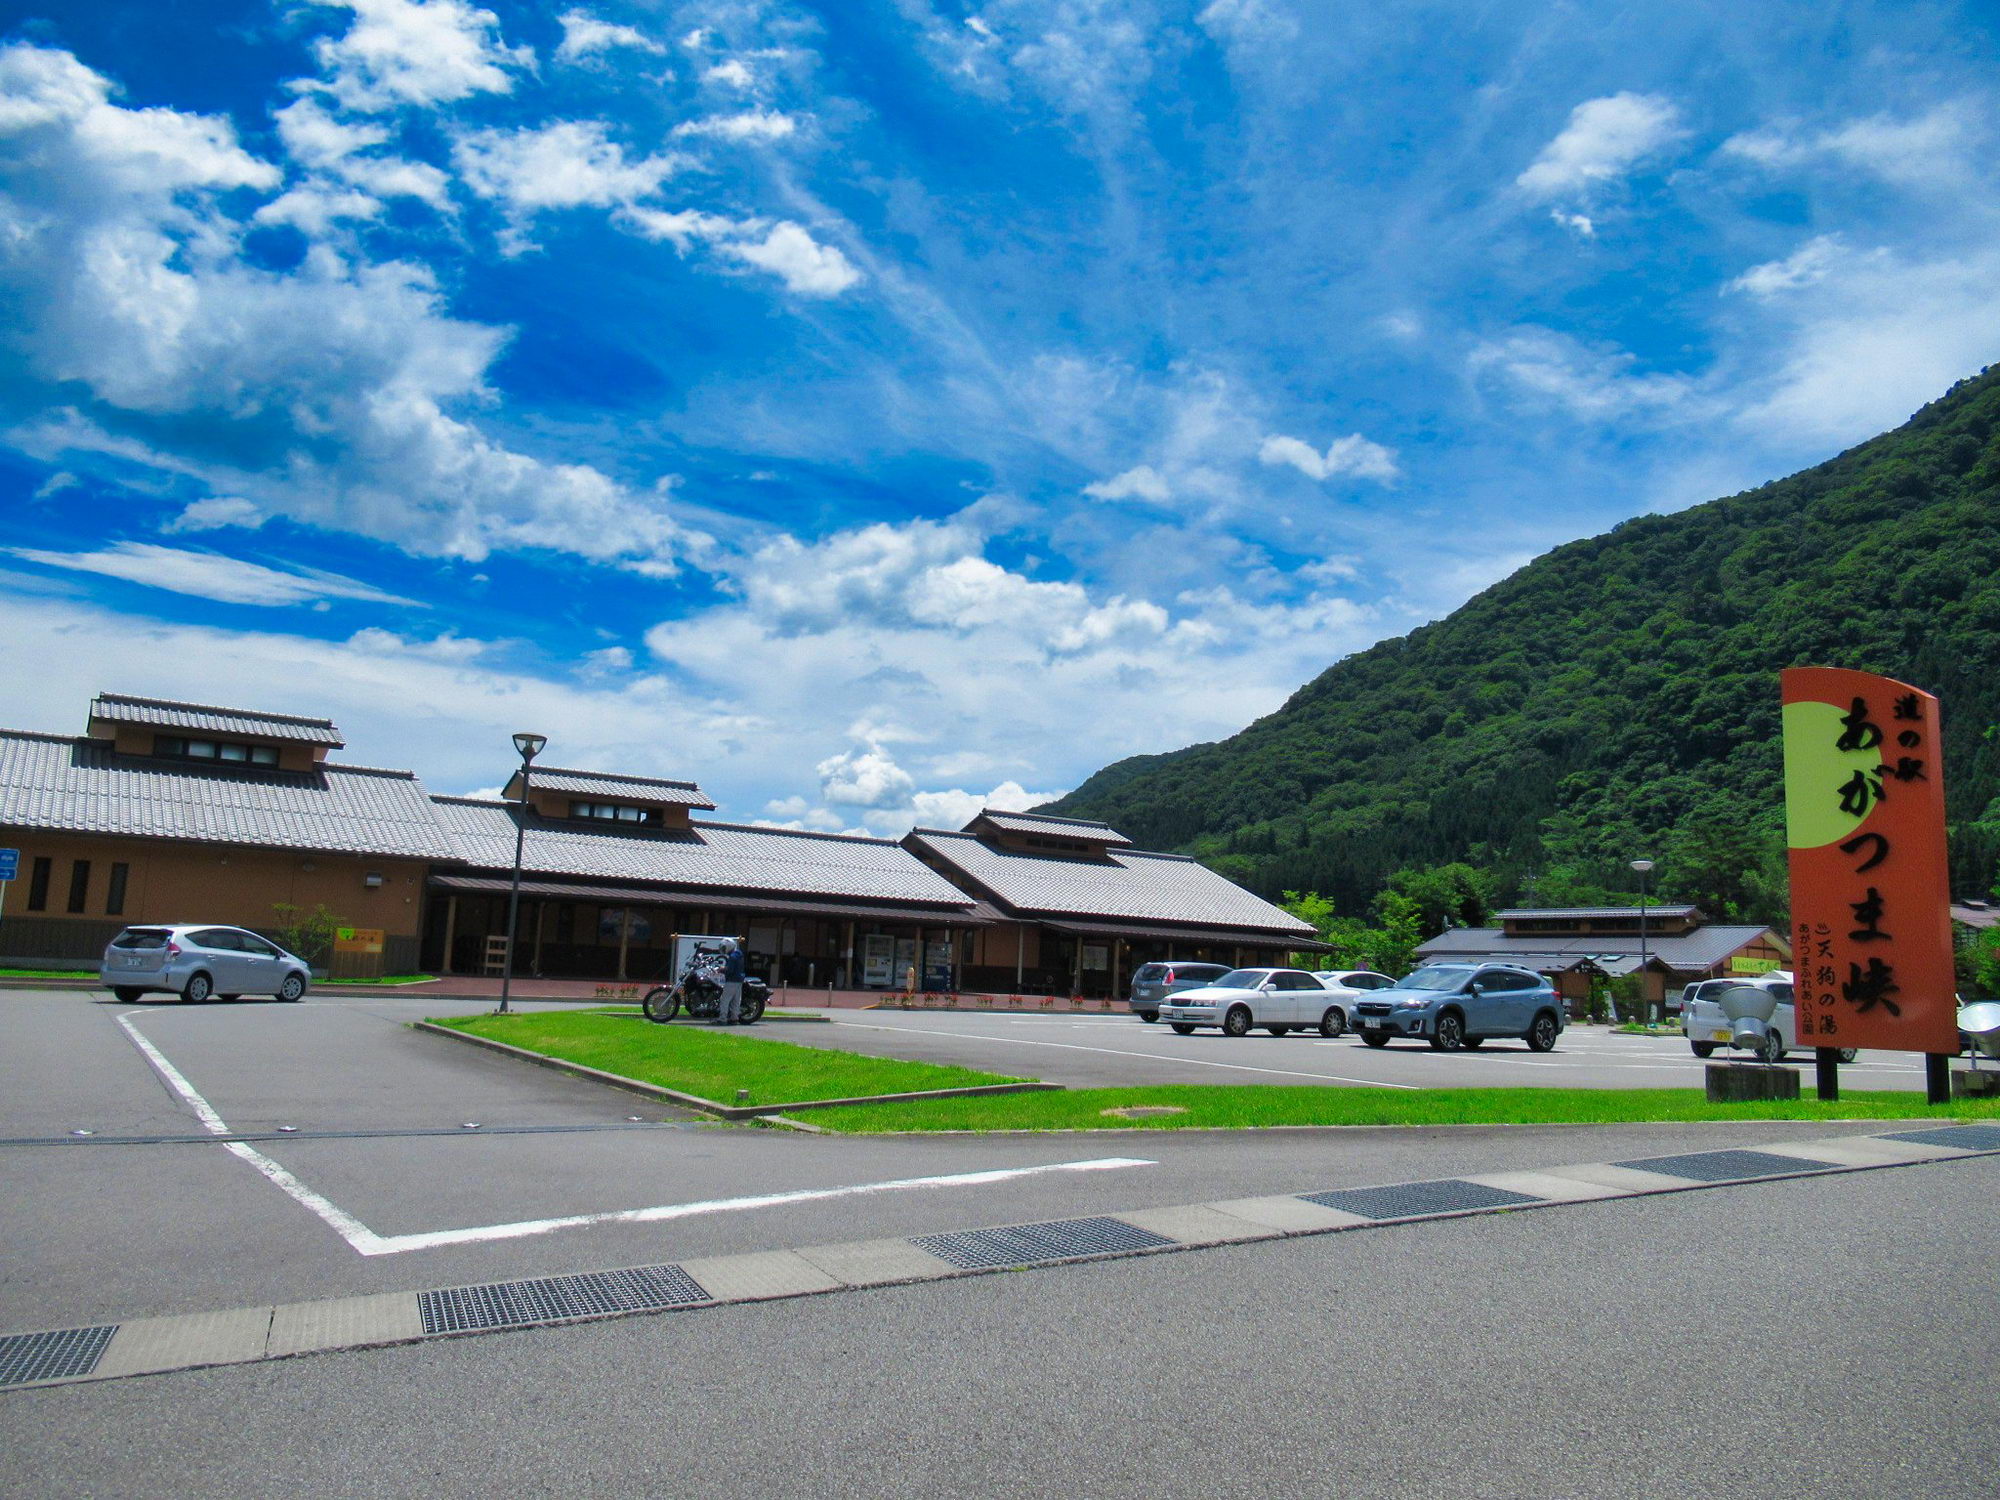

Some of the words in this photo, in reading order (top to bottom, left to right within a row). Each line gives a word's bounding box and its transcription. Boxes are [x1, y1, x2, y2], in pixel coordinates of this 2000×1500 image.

[1893, 693, 1927, 782] 道の駅
[1836, 697, 1901, 1017] あがつま峡
[1799, 923, 1814, 1035] あがつまふれあい公園
[1816, 939, 1838, 1035] 天狗の湯
